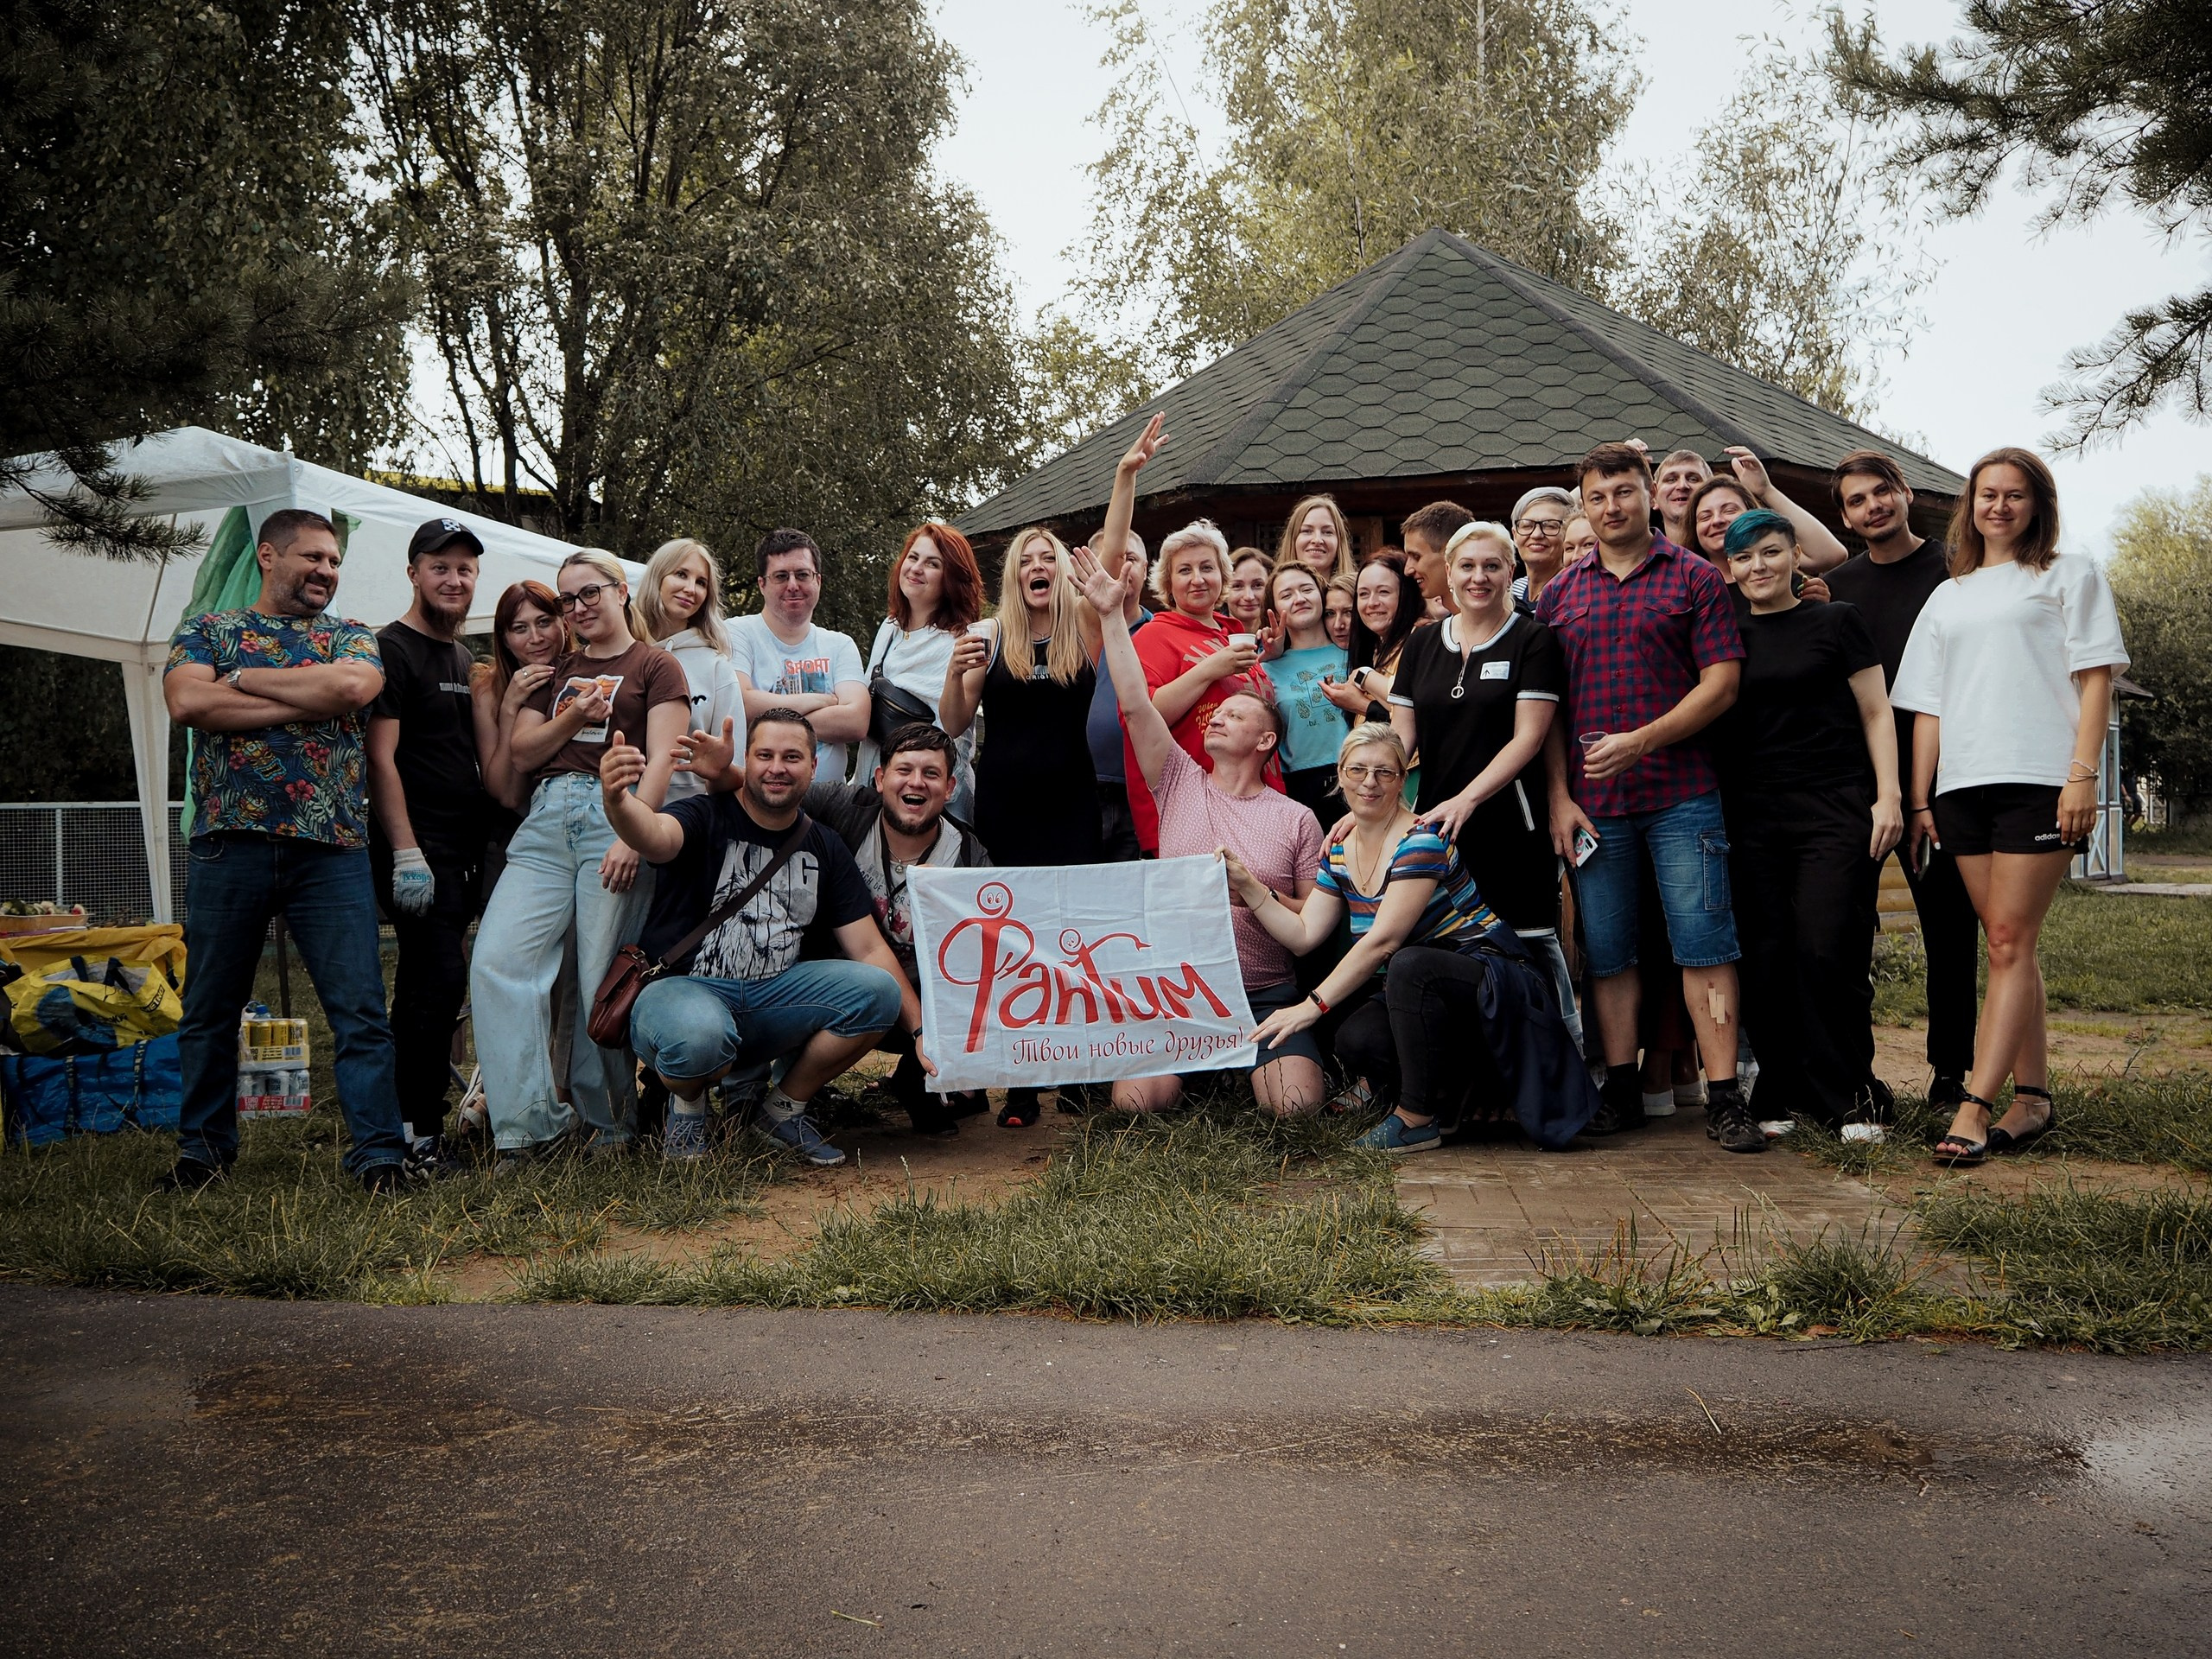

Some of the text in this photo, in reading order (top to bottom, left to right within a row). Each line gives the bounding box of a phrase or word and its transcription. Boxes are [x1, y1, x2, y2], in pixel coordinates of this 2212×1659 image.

[785, 658, 830, 674] SPORT
[1013, 1026, 1244, 1065] Твои новые друзья!
